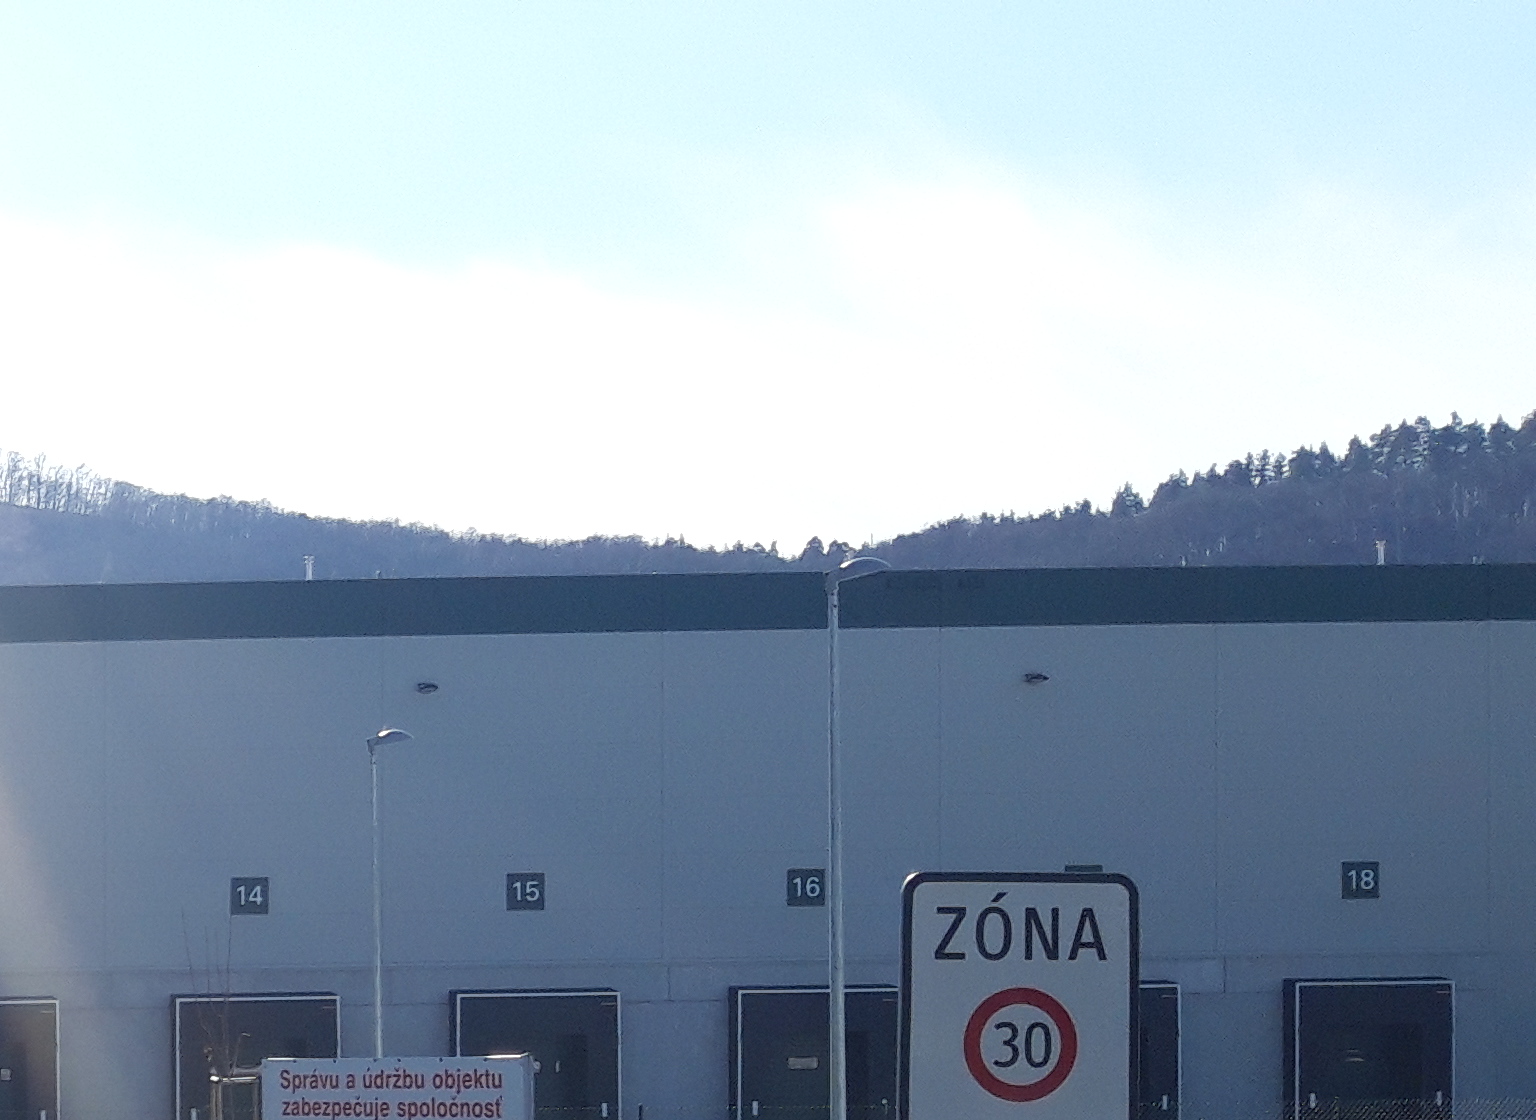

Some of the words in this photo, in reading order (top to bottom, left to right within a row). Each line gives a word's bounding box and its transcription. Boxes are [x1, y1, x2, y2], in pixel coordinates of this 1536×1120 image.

[793, 876, 820, 897] 16
[1347, 869, 1375, 890] 18
[236, 885, 263, 906] 14
[512, 880, 539, 902] 15
[934, 892, 1108, 961] ZÓNA
[992, 1021, 1053, 1069] 30
[280, 1068, 340, 1093] Správu
[346, 1073, 355, 1090] a
[363, 1067, 425, 1090] údržbu
[432, 1068, 503, 1095] objektu
